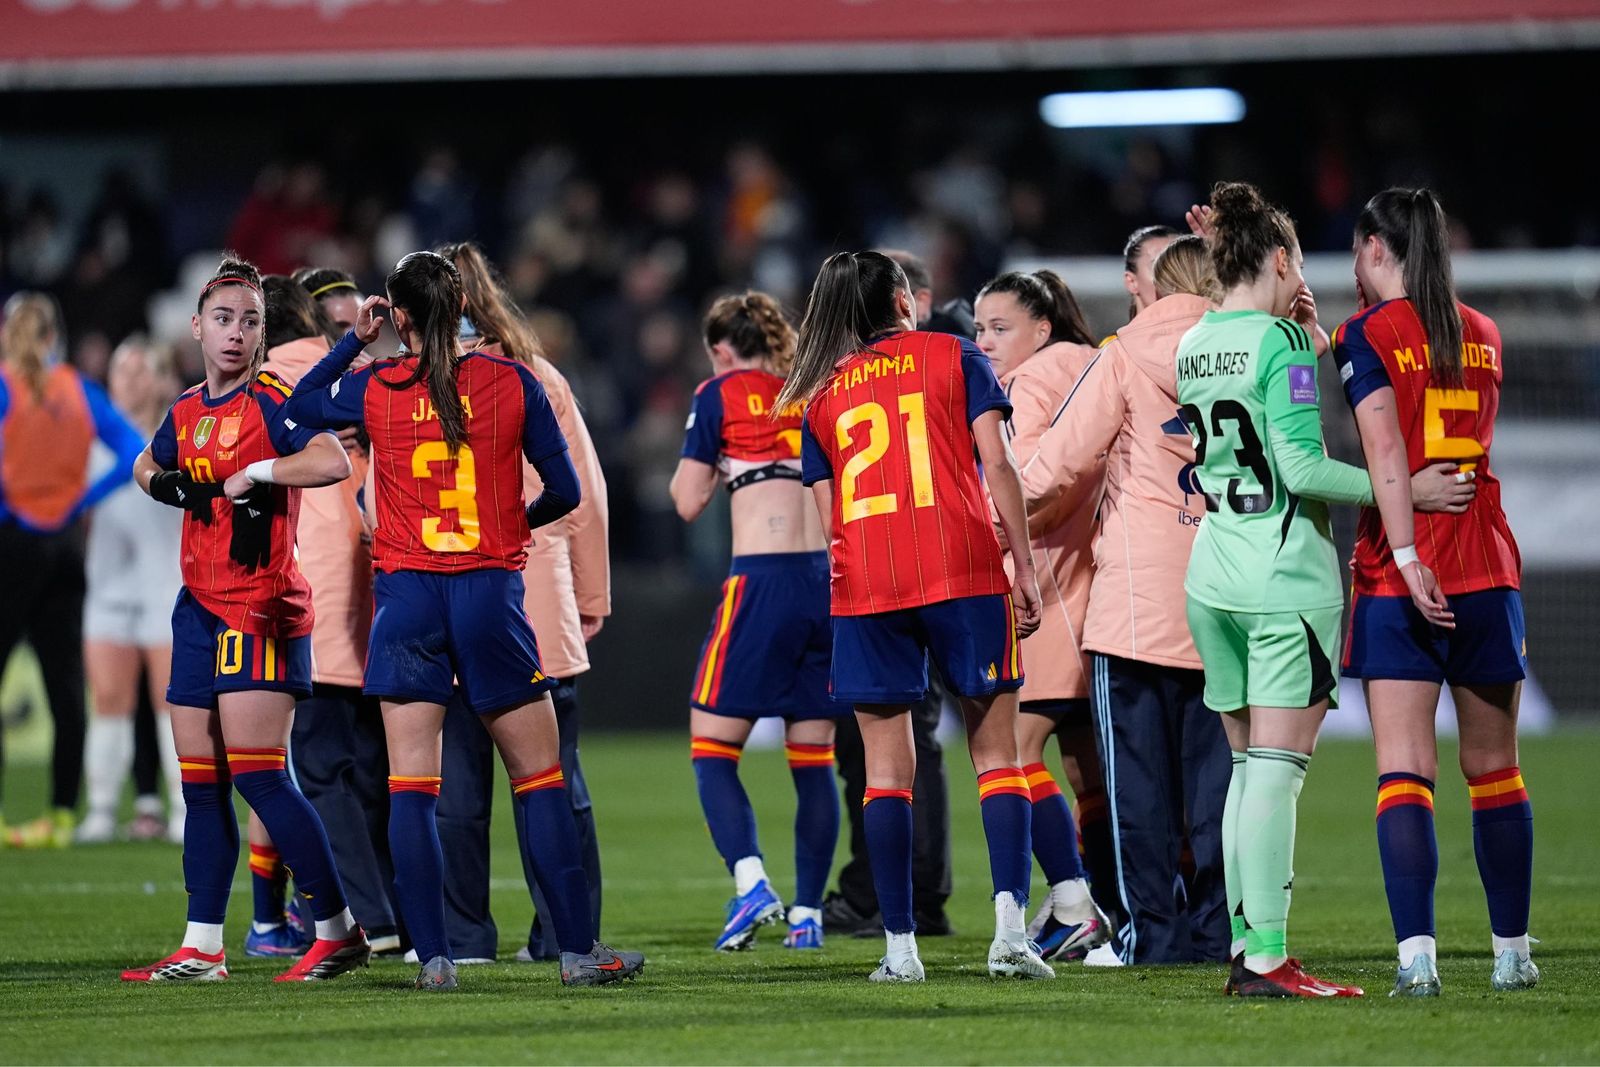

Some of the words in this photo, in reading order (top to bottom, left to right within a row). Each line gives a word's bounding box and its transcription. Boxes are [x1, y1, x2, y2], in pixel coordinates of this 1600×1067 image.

[412, 395, 473, 421] JAA
[833, 354, 916, 397] FIAMMA
[836, 391, 935, 524] 21
[1181, 400, 1274, 515] 23
[1424, 387, 1485, 473] 5
[412, 441, 480, 552] 3
